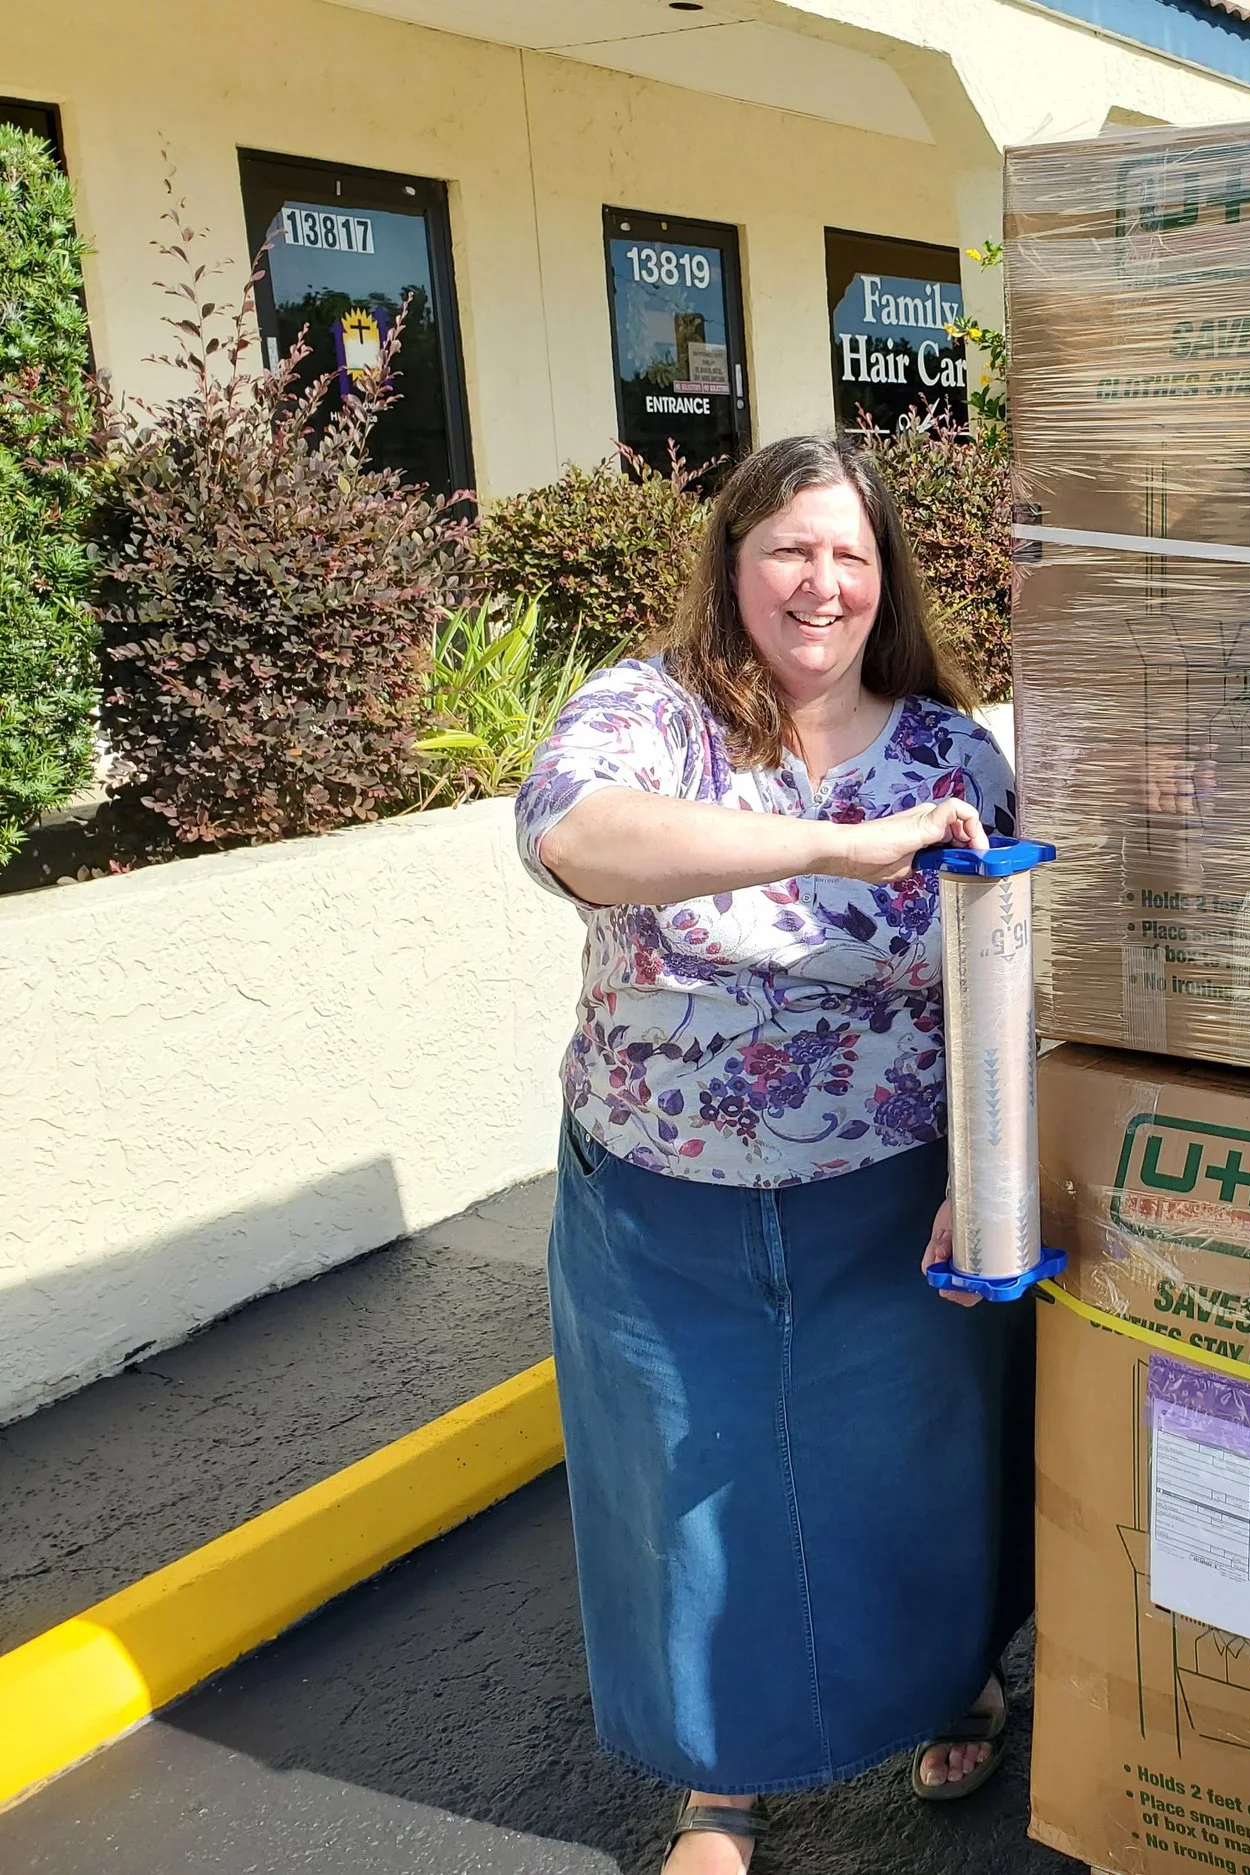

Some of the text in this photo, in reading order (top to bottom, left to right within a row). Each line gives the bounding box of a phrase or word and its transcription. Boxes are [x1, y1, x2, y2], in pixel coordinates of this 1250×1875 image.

[286, 210, 370, 251] 13817
[627, 246, 710, 289] 13819
[860, 275, 958, 340] Family
[839, 333, 967, 387] Hair Car
[646, 396, 710, 414] ENTRANCE
[1142, 921, 1187, 941] Place
[1137, 1765, 1185, 1795] Holds
[1190, 1784, 1202, 1800] 2
[1207, 1789, 1242, 1813] feet
[1140, 1791, 1185, 1817] Place
[1143, 1812, 1159, 1827] of
[1164, 1816, 1197, 1838] box
[1201, 1828, 1219, 1845] to
[1145, 1832, 1168, 1851] No
[1174, 1841, 1236, 1875] ironing
